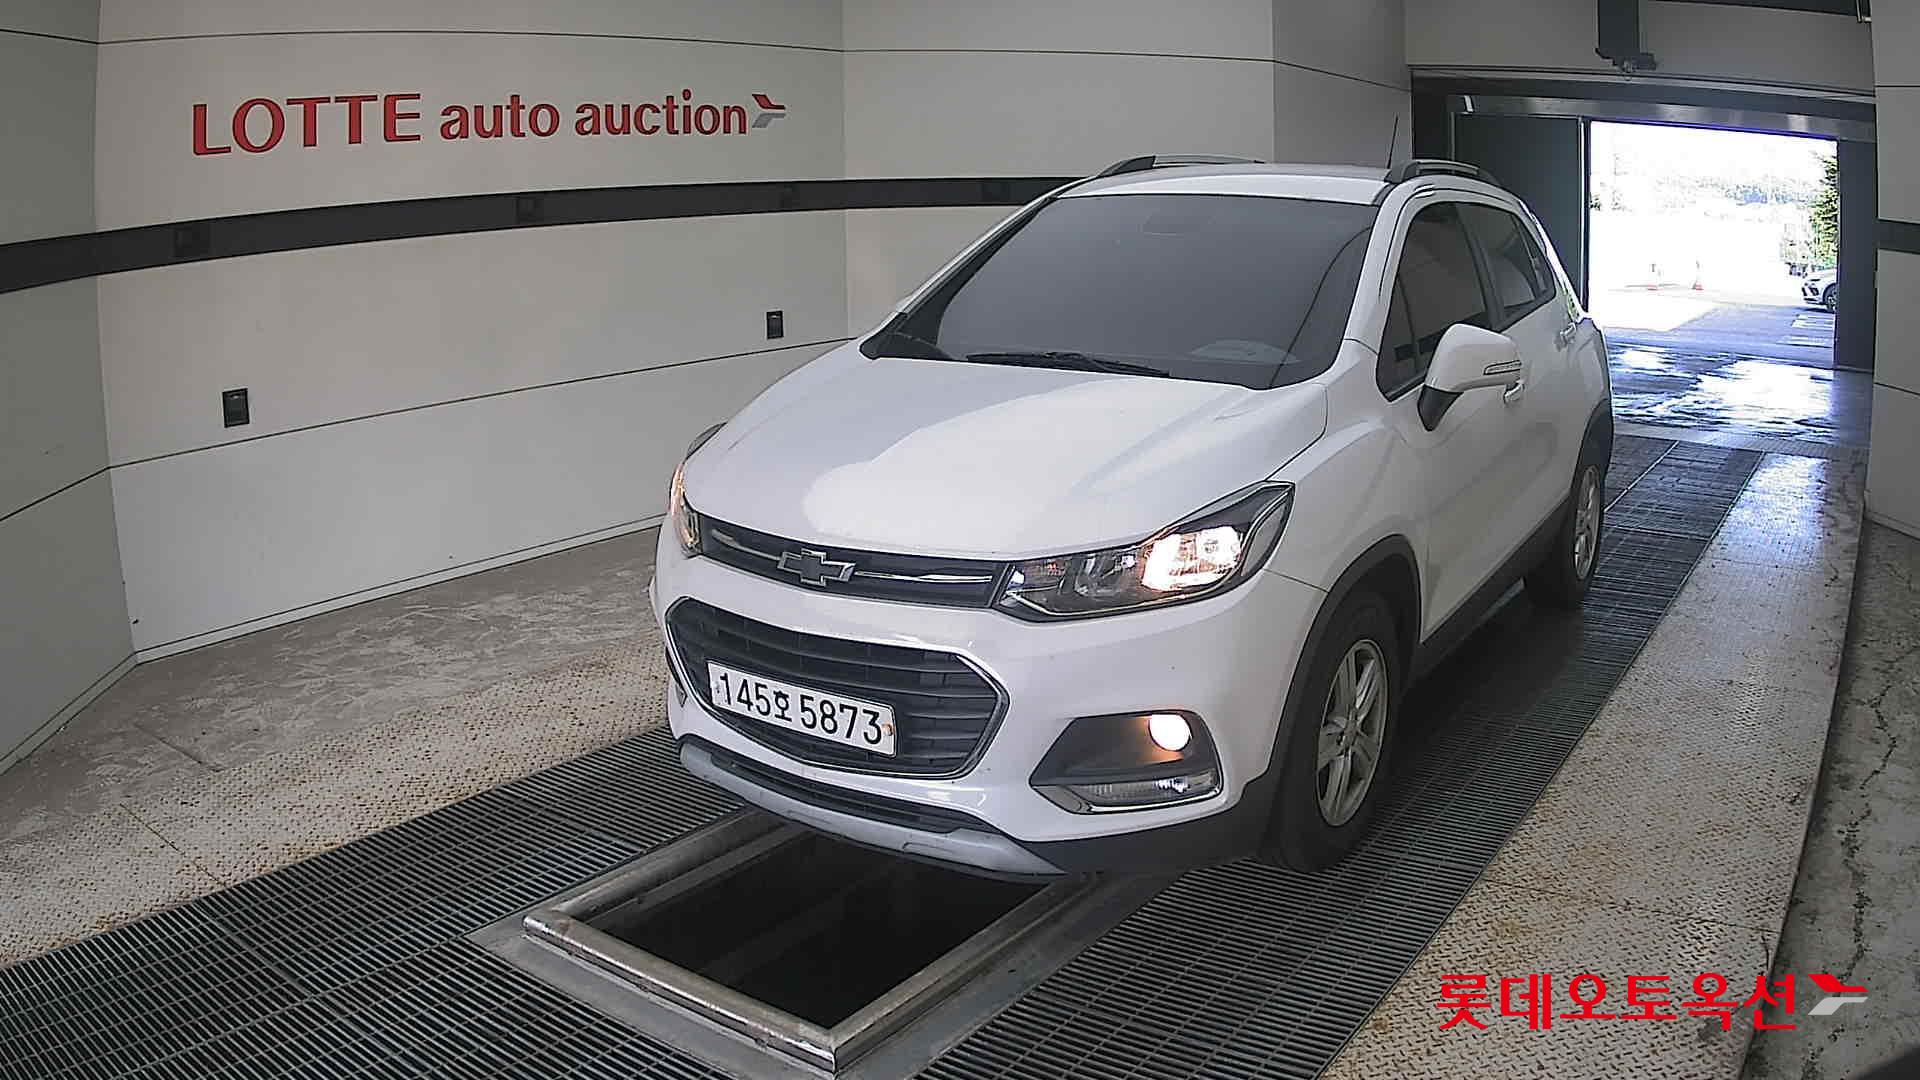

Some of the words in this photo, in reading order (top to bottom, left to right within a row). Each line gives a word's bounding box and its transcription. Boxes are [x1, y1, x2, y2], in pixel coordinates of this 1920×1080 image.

[192, 92, 421, 156] LOTTE
[439, 94, 560, 140] auto
[575, 89, 748, 136] auction
[719, 672, 793, 723] 145호
[799, 693, 883, 745] 5873
